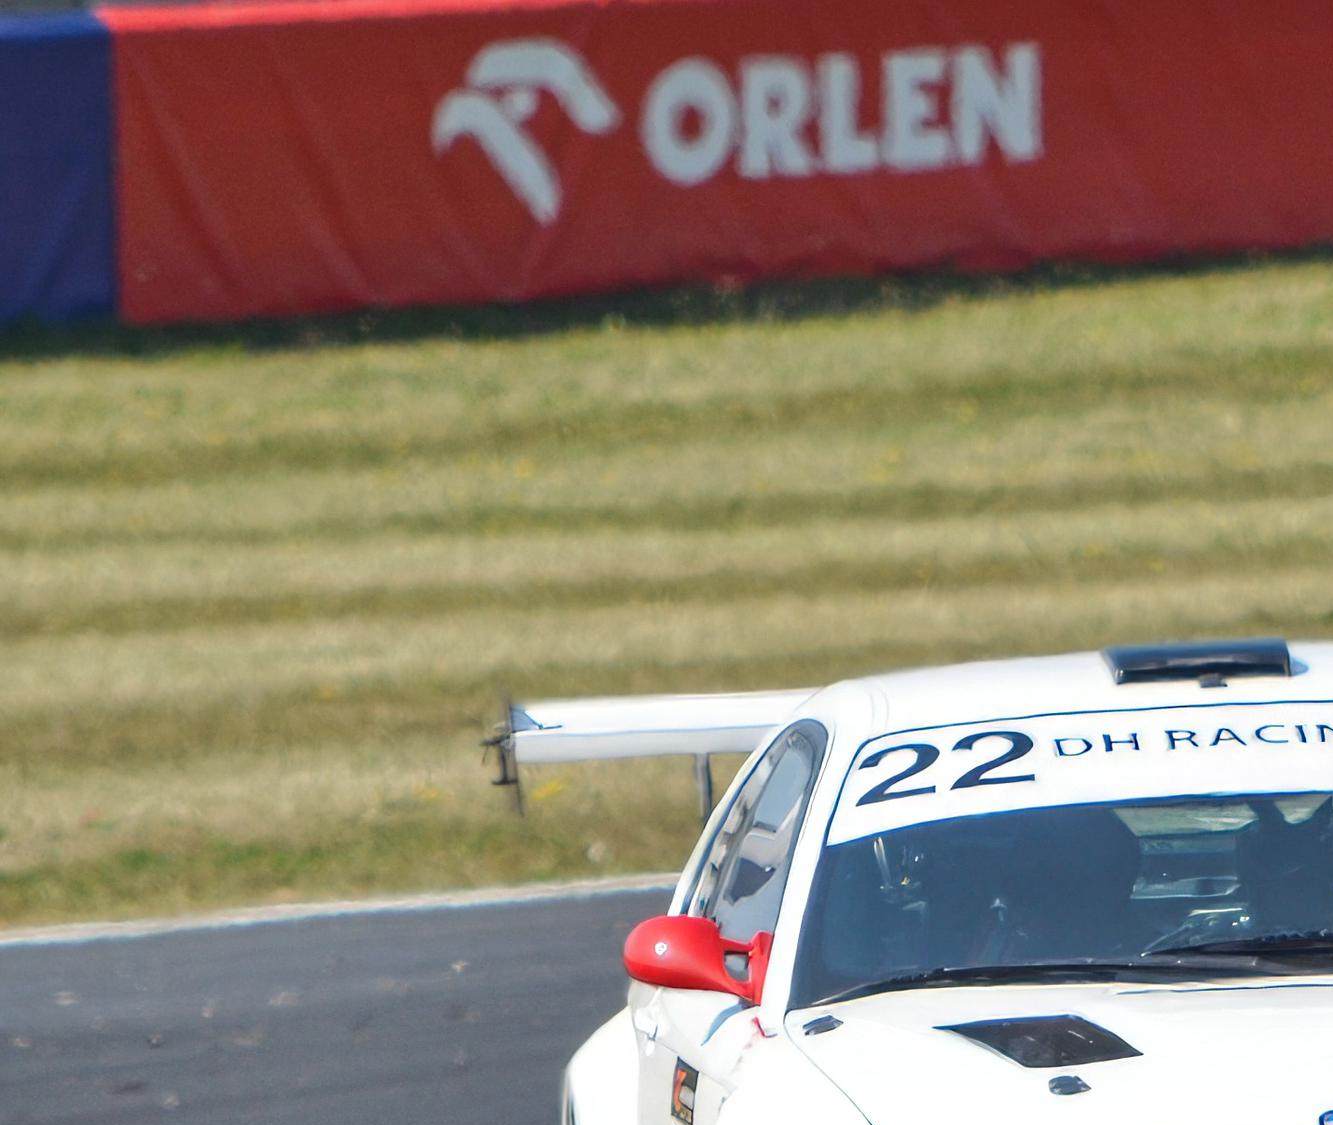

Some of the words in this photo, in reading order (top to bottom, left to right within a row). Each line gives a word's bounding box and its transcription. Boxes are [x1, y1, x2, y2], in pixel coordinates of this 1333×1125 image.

[640, 40, 1043, 187] ORLEN
[855, 731, 1036, 807] 22
[1053, 731, 1140, 758] DH
